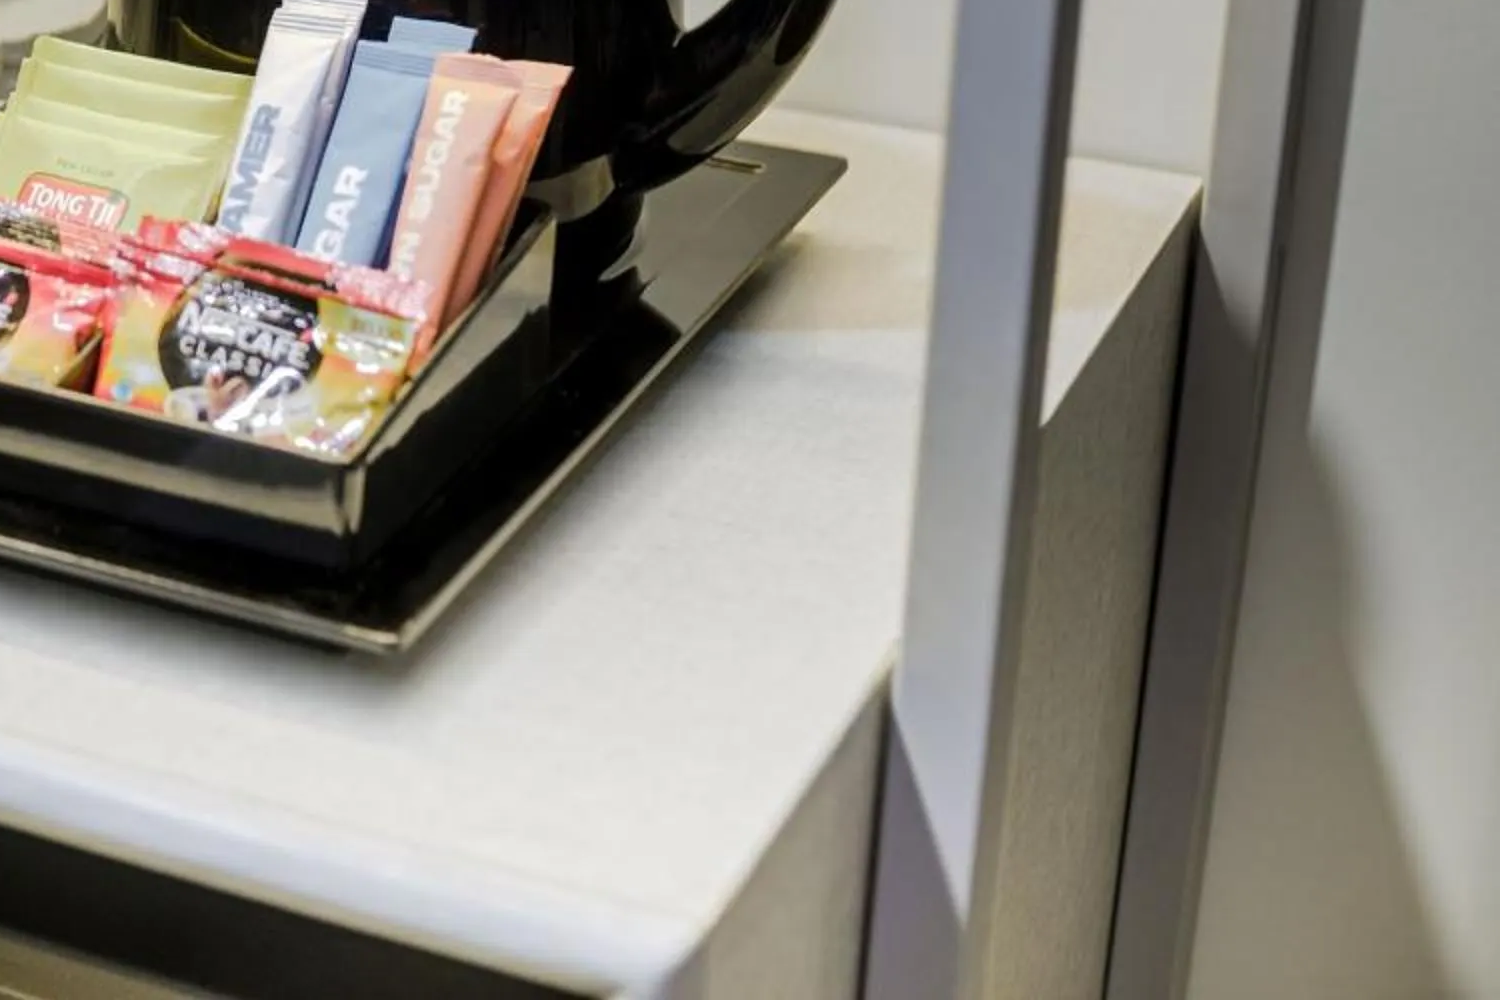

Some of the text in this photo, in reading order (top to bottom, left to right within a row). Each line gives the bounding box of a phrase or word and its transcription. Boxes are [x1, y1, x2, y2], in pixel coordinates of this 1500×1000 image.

[27, 182, 84, 216] TONG
[219, 103, 281, 232] AMER
[407, 89, 470, 223] SUGAR
[313, 164, 369, 259] GAR
[179, 334, 274, 380] CLASSI
